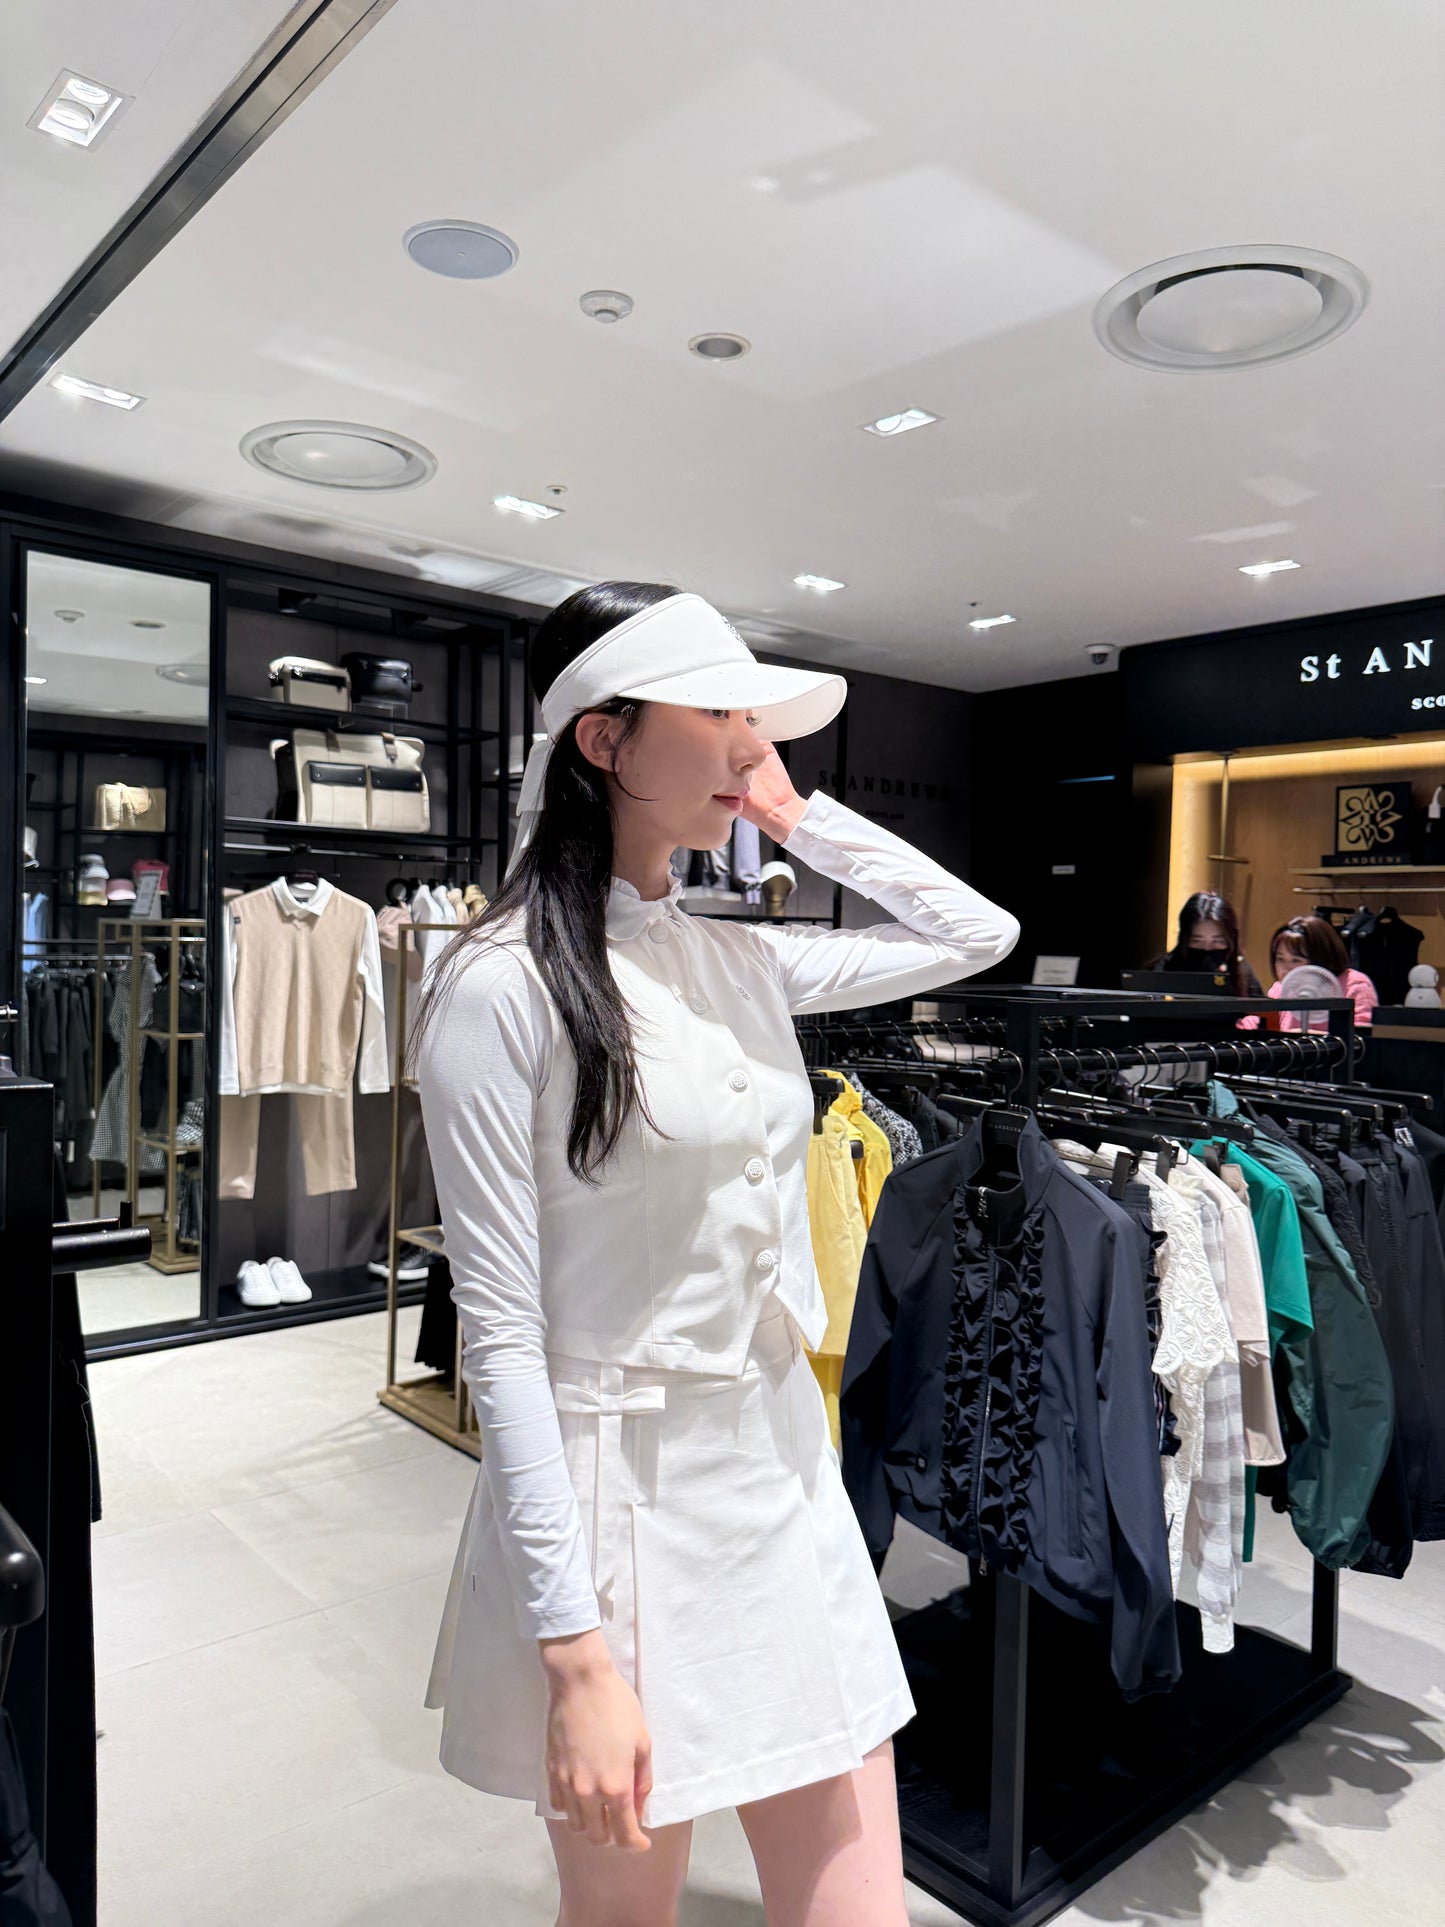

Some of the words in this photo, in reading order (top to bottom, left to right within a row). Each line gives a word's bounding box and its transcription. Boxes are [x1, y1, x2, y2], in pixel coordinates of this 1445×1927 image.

[1300, 653, 1342, 683] St
[1362, 639, 1434, 675] AN
[1411, 694, 1445, 711] sco
[1343, 855, 1402, 865] ANDREWS
